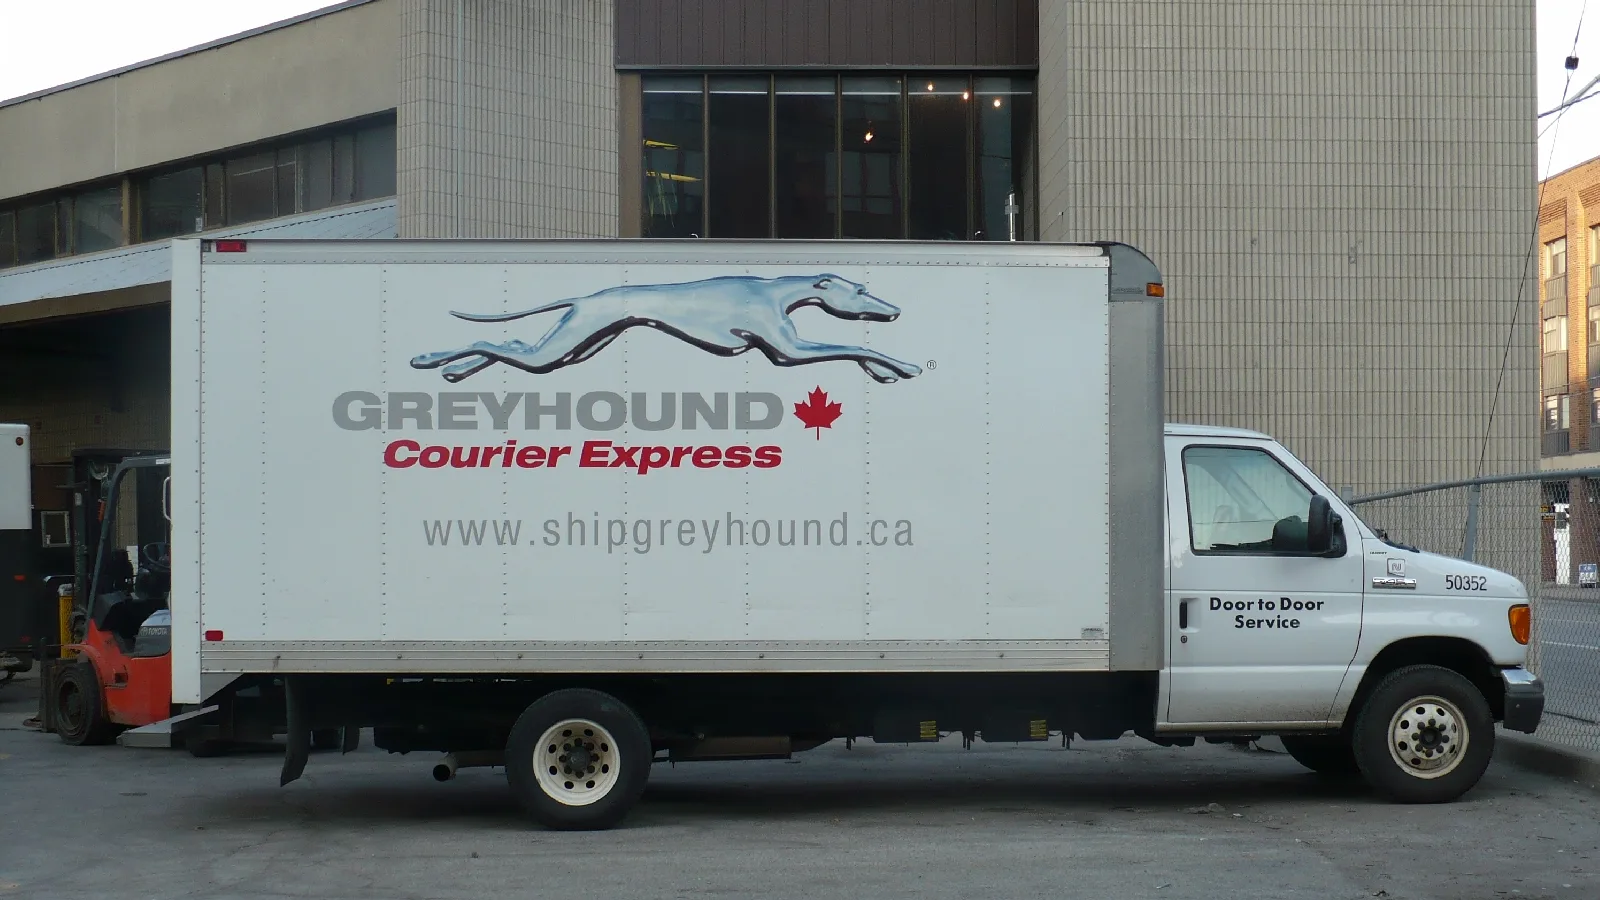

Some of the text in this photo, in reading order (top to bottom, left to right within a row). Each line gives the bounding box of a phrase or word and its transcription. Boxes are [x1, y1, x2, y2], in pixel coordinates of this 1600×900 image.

[332, 391, 783, 431] GREYHOUND
[384, 440, 782, 475] Courier Express
[423, 512, 914, 555] www.shipgreyhound.ca
[1445, 574, 1488, 591] 50352
[1210, 597, 1325, 611] Door to Door
[1234, 614, 1301, 629] Service
